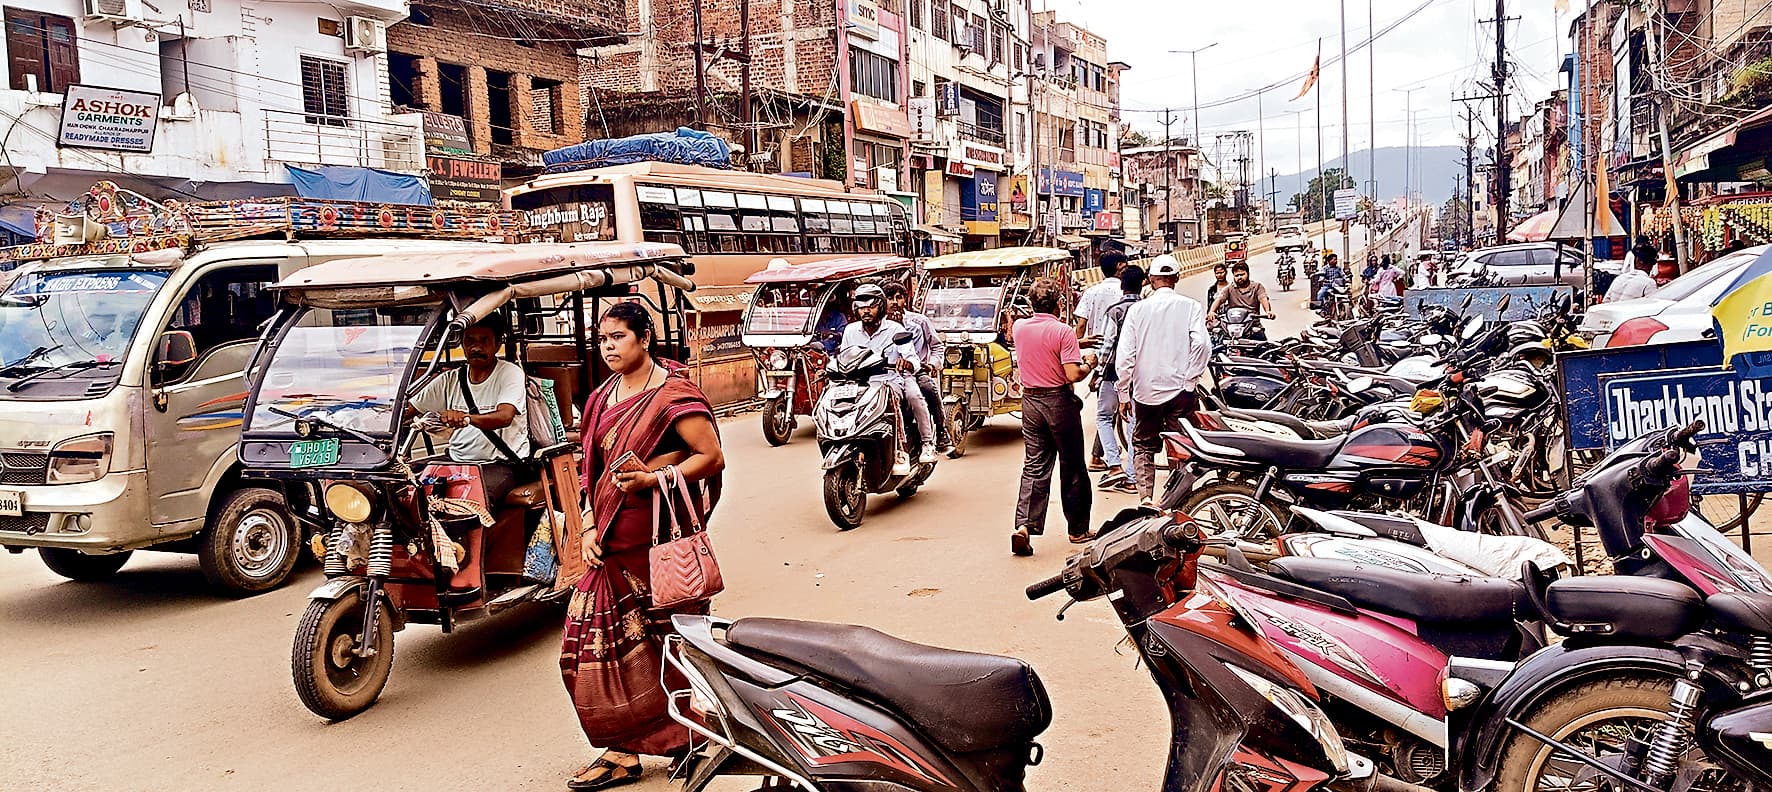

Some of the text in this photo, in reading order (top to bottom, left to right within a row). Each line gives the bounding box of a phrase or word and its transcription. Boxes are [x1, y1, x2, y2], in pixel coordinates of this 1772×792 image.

[70, 98, 152, 118] ASHOK
[77, 112, 143, 126] GARMENTS
[65, 132, 144, 145] READYMADE DRESSES
[449, 159, 500, 181] JEWELLERS
[579, 202, 606, 227] Raja
[71, 276, 122, 291] EXPRESS
[1612, 380, 1739, 441] Jharkhand
